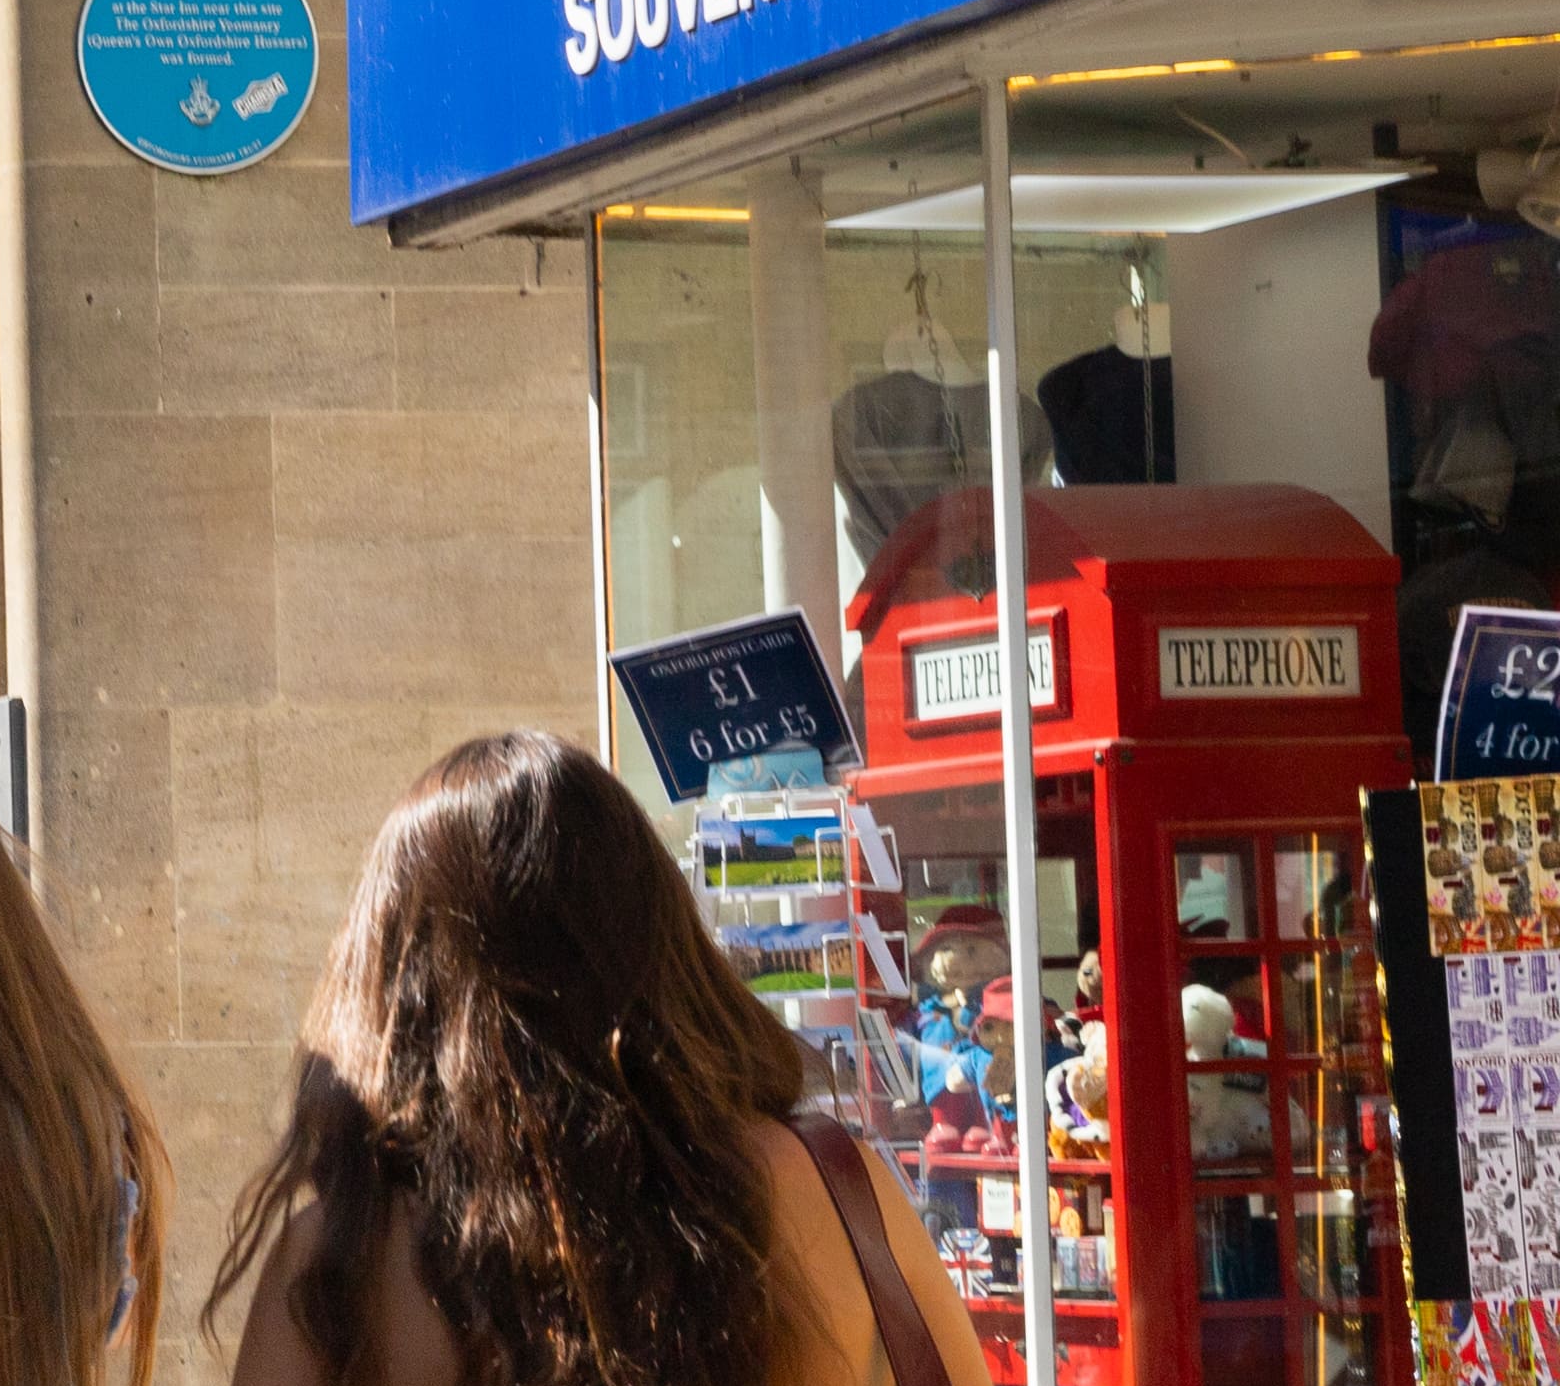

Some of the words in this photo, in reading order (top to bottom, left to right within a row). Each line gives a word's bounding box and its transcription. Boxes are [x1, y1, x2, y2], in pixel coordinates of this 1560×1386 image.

[116, 16, 139, 32] The
[142, 16, 217, 32] Oxfordshire
[127, 1, 148, 15] the
[150, 1, 175, 16] Star
[179, 2, 200, 16] Inn
[204, 4, 232, 16] near
[233, 1, 258, 16] this
[145, 35, 174, 49] Own
[177, 34, 252, 50] Oxfordshire
[160, 53, 184, 66] was
[650, 650, 710, 678] OXFORD
[709, 629, 795, 661] POSTCARDS
[919, 635, 1053, 706] TELEPHNE
[1167, 635, 1347, 689] TELEPHONE
[708, 663, 758, 709] £1
[689, 727, 713, 762] 6
[719, 718, 769, 754] for
[779, 703, 818, 739] £5
[1475, 721, 1495, 758] 4
[1504, 721, 1560, 761] for
